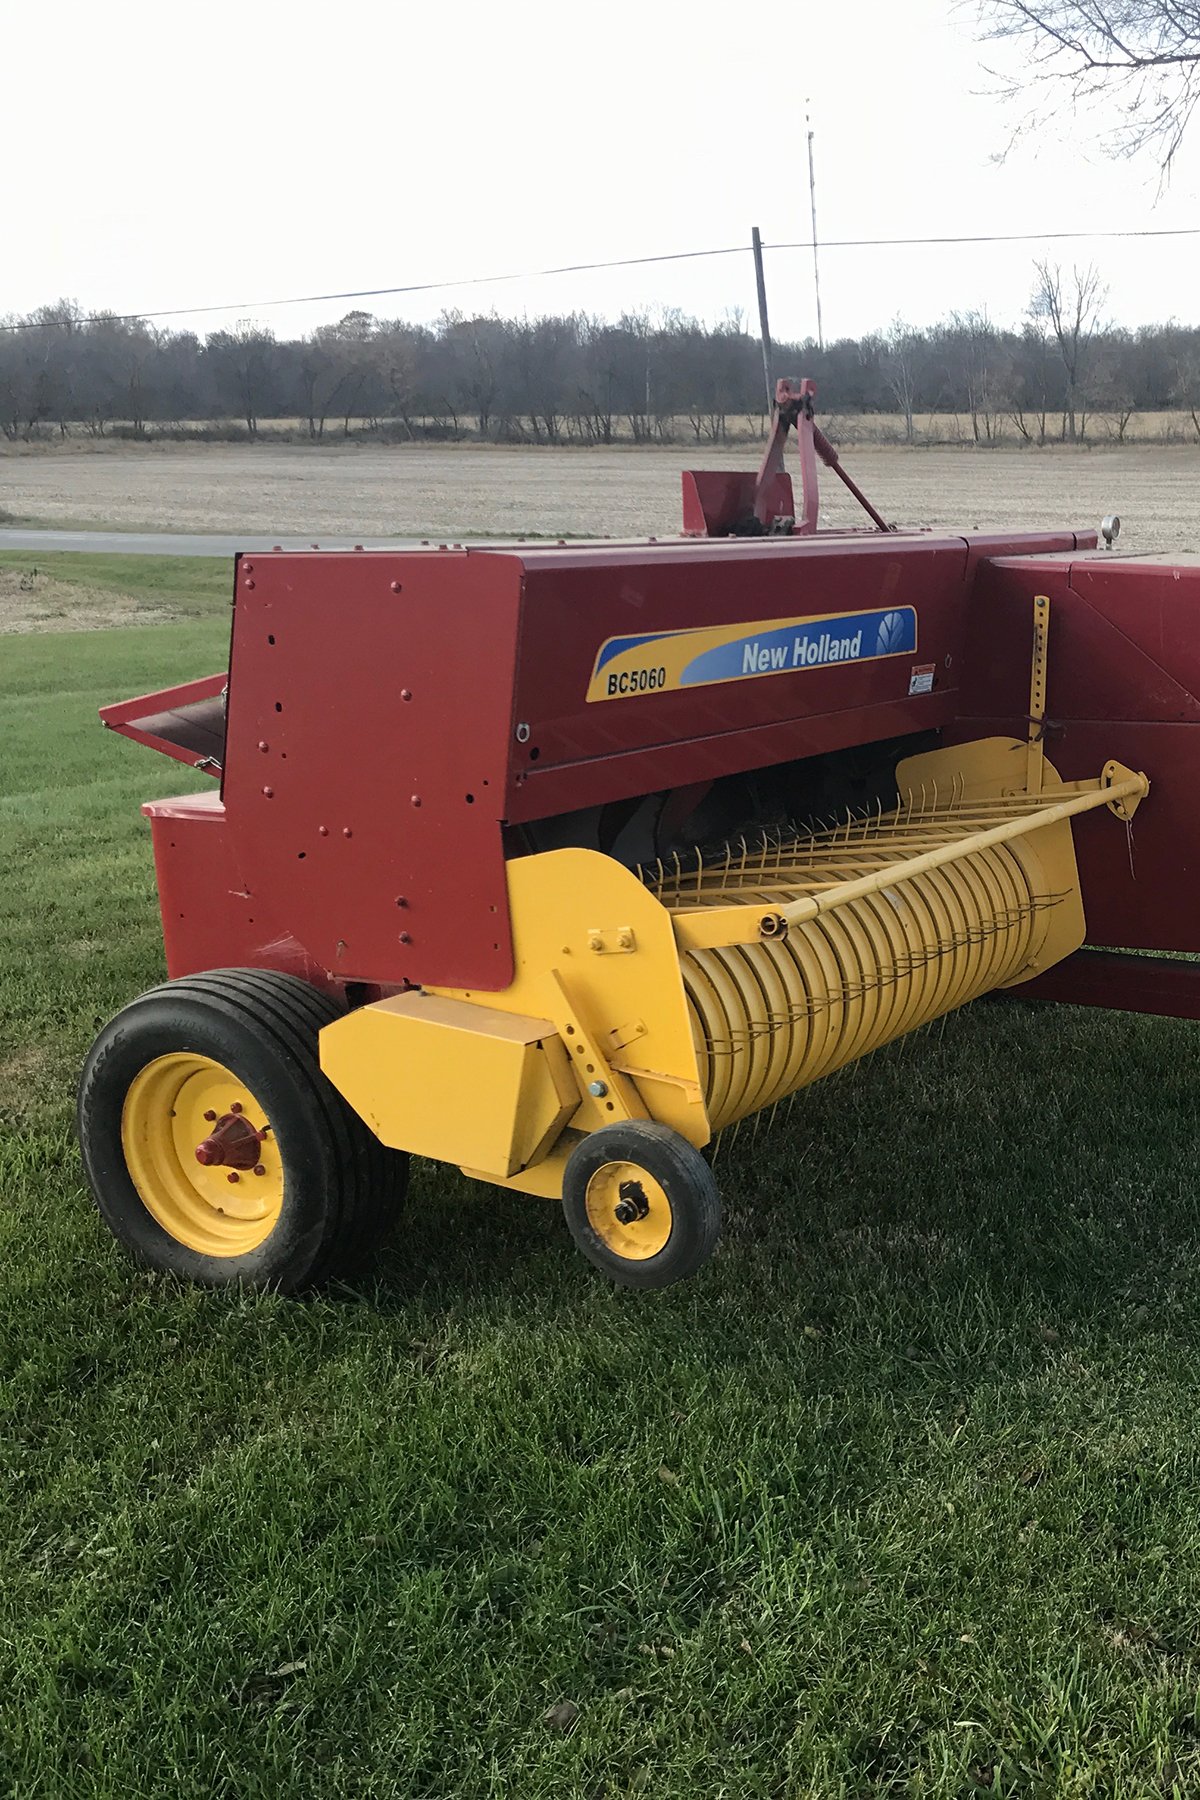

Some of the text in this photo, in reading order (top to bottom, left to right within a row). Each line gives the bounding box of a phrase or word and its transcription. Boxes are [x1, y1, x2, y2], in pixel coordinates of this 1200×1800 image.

[742, 629, 863, 673] New Holland
[607, 666, 667, 695] BC5060
